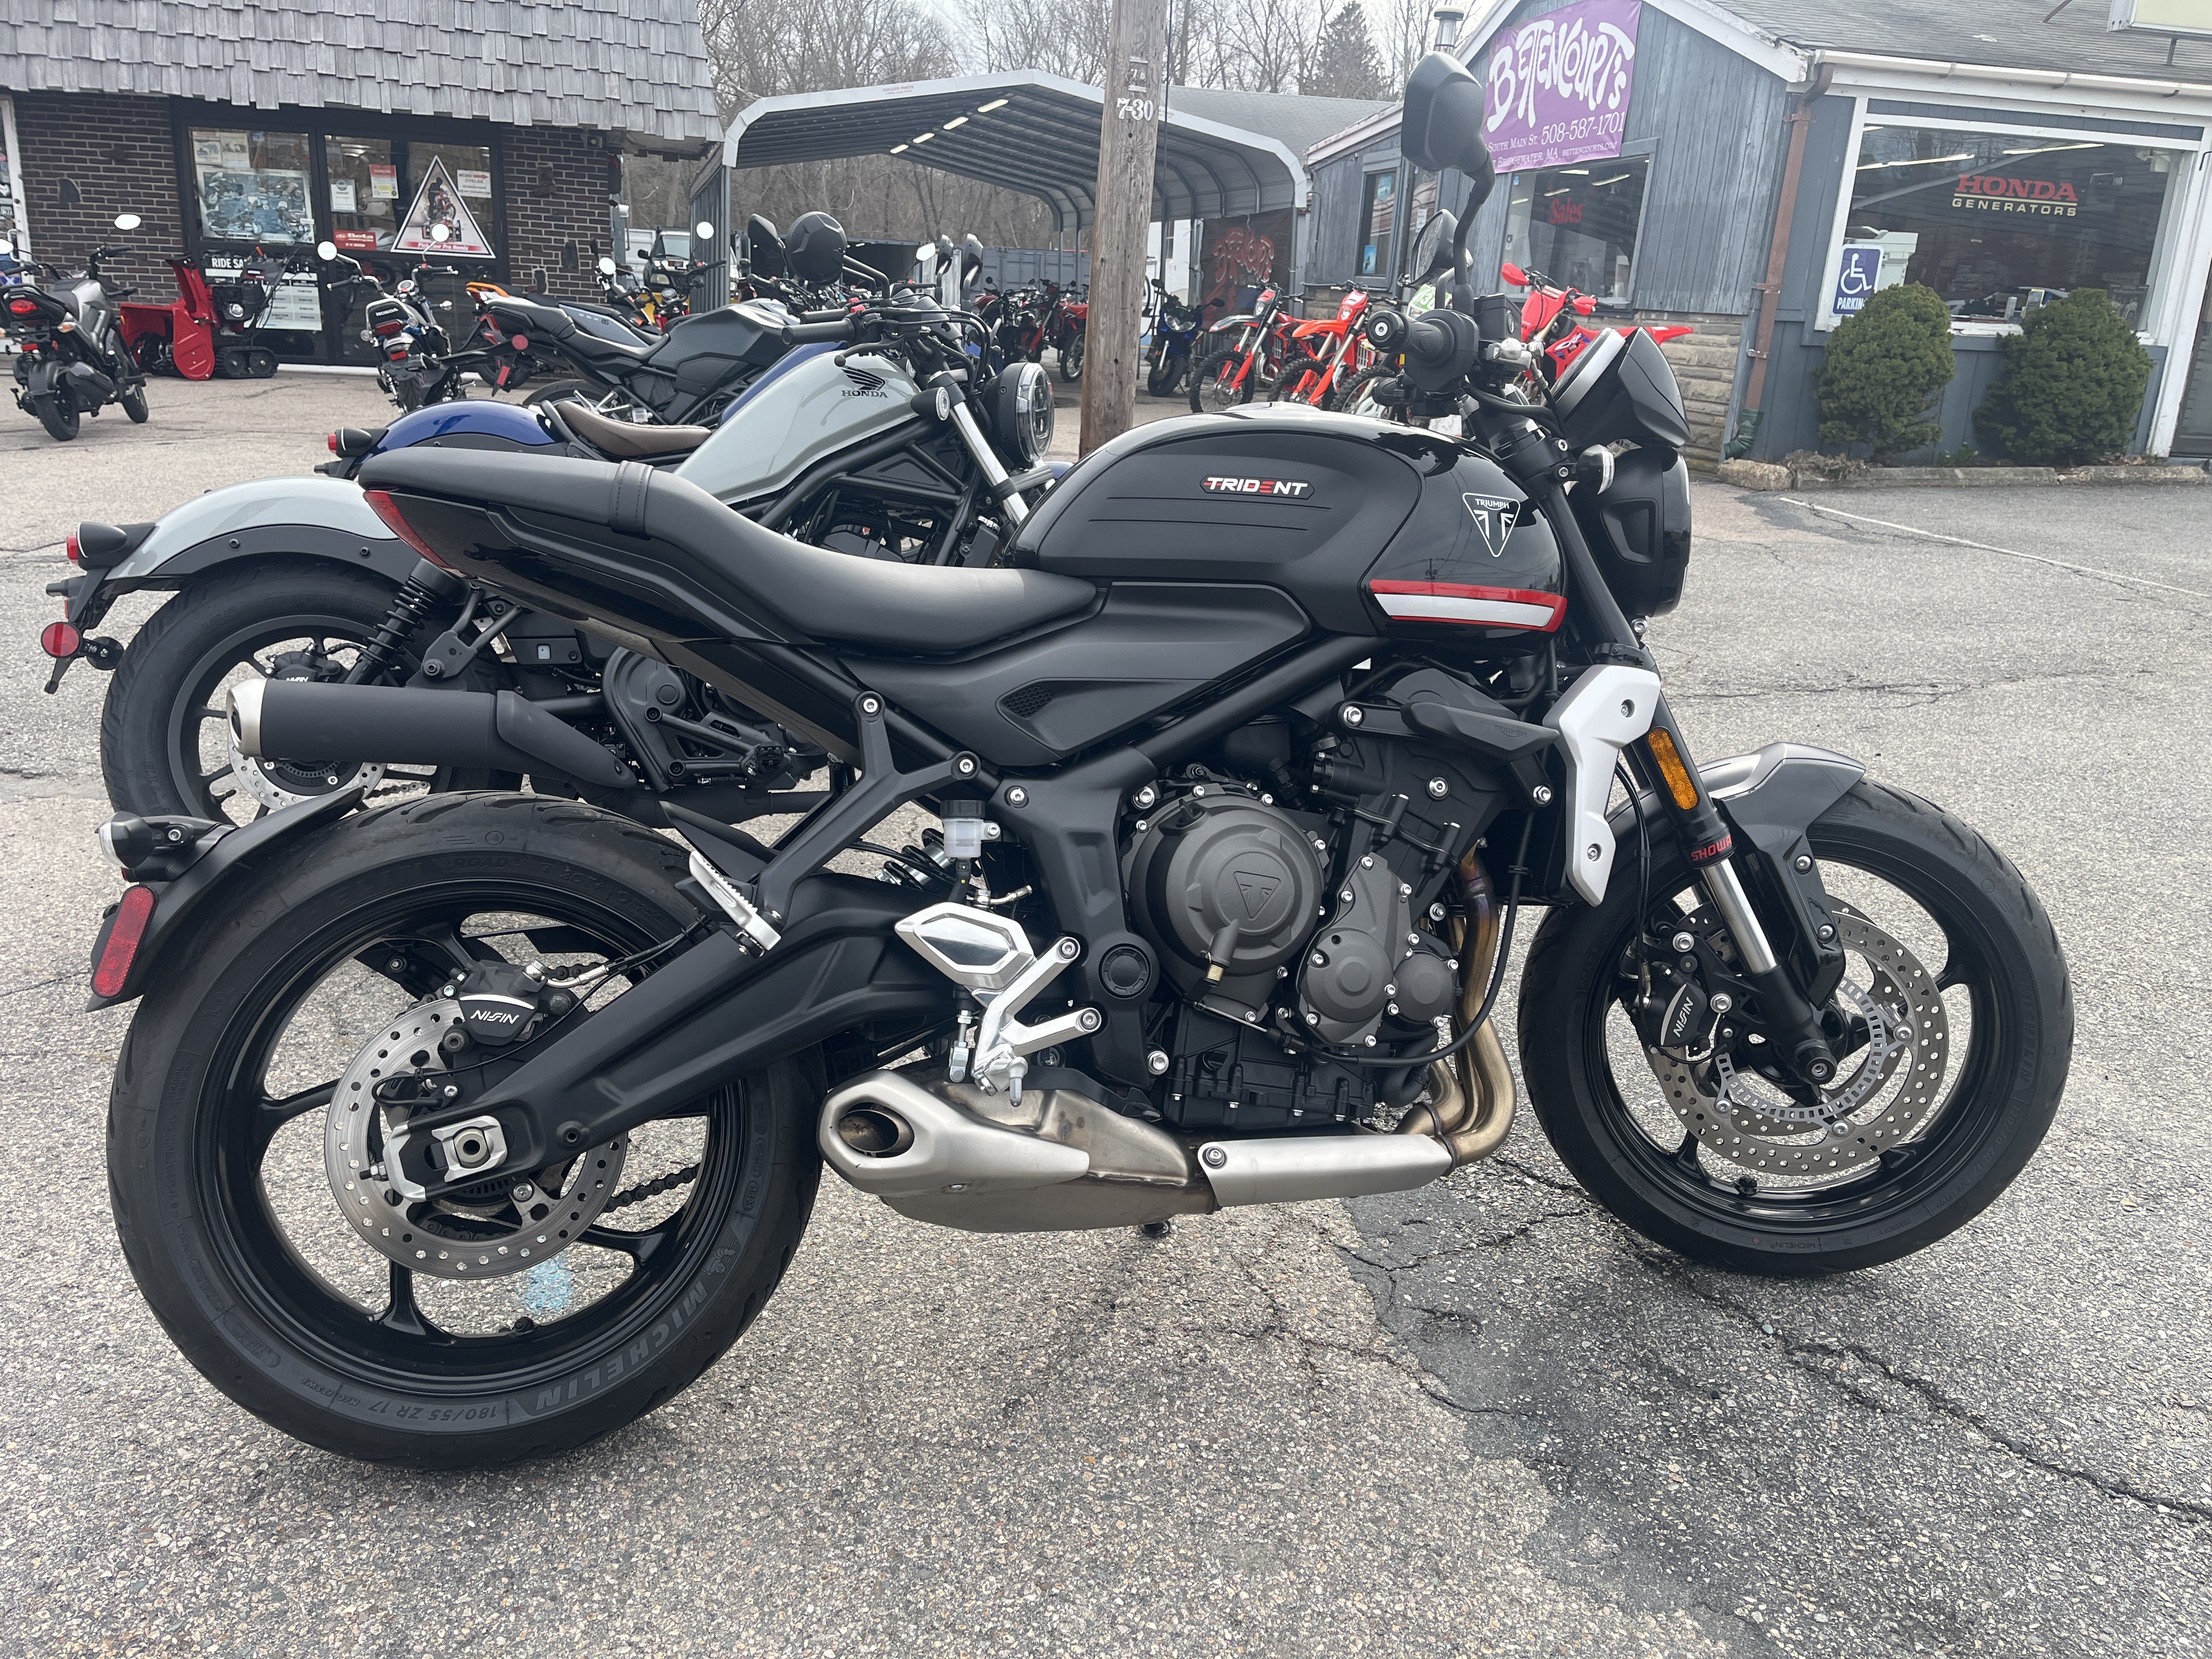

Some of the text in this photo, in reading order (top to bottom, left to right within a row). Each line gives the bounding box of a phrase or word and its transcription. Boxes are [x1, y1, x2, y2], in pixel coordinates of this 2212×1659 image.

[1116, 98, 1154, 121] 7-30
[1488, 140, 1509, 153] SOUTH
[1510, 138, 1528, 150] MAIN
[1541, 111, 1626, 145] 508-587-1701
[1546, 148, 1559, 159] MA
[1955, 174, 2078, 202] HONDA
[1549, 198, 1583, 224] Sales
[1953, 198, 2078, 217] GENERATORS
[211, 257, 232, 268] RIDE
[1837, 297, 1865, 310] PARKIN
[842, 390, 889, 399] HONDA
[1204, 476, 1308, 496] TRIDENT
[1474, 498, 1510, 510] TRIUMPH
[1493, 724, 1528, 738] TRIUMPH
[1690, 834, 1733, 862] SHOWA
[470, 1009, 520, 1025] NISSIN
[1673, 996, 1694, 1038] NISSIN
[534, 1279, 709, 1412] MICHELIN
[368, 1400, 391, 1414] 17
[395, 1404, 424, 1420] ZR
[428, 1406, 498, 1421] 180/55
